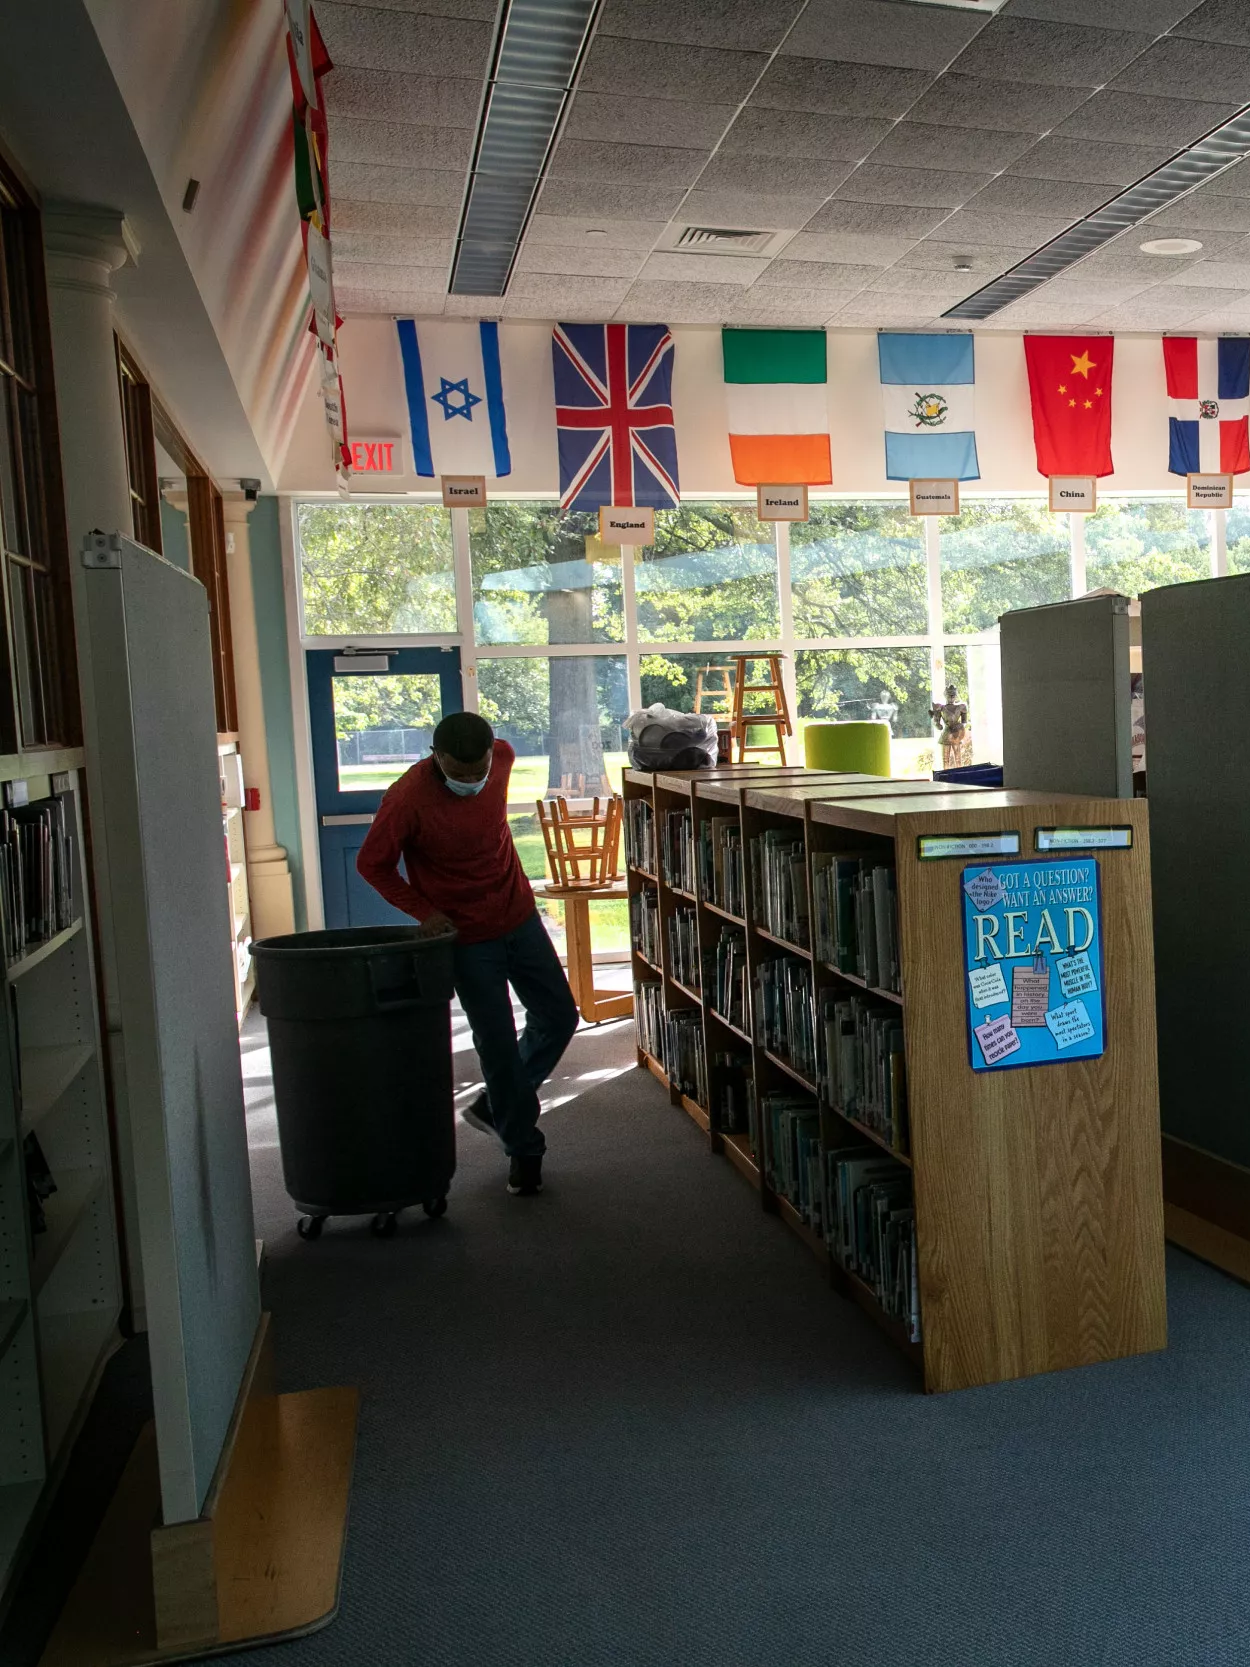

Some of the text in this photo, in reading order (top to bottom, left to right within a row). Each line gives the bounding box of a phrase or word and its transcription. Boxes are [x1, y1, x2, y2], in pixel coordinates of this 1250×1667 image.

[351, 442, 394, 472] EXIT
[448, 487, 479, 495] Israel
[1059, 490, 1085, 498] China
[765, 498, 799, 506] Ireland
[609, 521, 646, 529] England
[998, 867, 1089, 890] GOT A QUESTION?
[971, 883, 999, 891] designed
[971, 890, 997, 898] the Nike
[1002, 886, 1093, 908] WANT AN ANSWER?
[976, 898, 994, 907] logo?
[972, 906, 1095, 961] READ
[1060, 964, 1090, 979] MOST POWERFUL
[1062, 960, 1077, 970] WHAT'S
[1063, 977, 1079, 986] MUSCLE
[1083, 972, 1091, 981] THE
[1067, 986, 1081, 995] HUMAN
[1050, 1007, 1077, 1021] What sport
[1055, 1022, 1091, 1037] most spectators
[1057, 1019, 1071, 1027] draws
[982, 1024, 1005, 1041] How many
[1073, 1027, 1091, 1039] season?
[983, 1030, 1014, 1052] times can you
[988, 1036, 1019, 1060] recycle paper?
